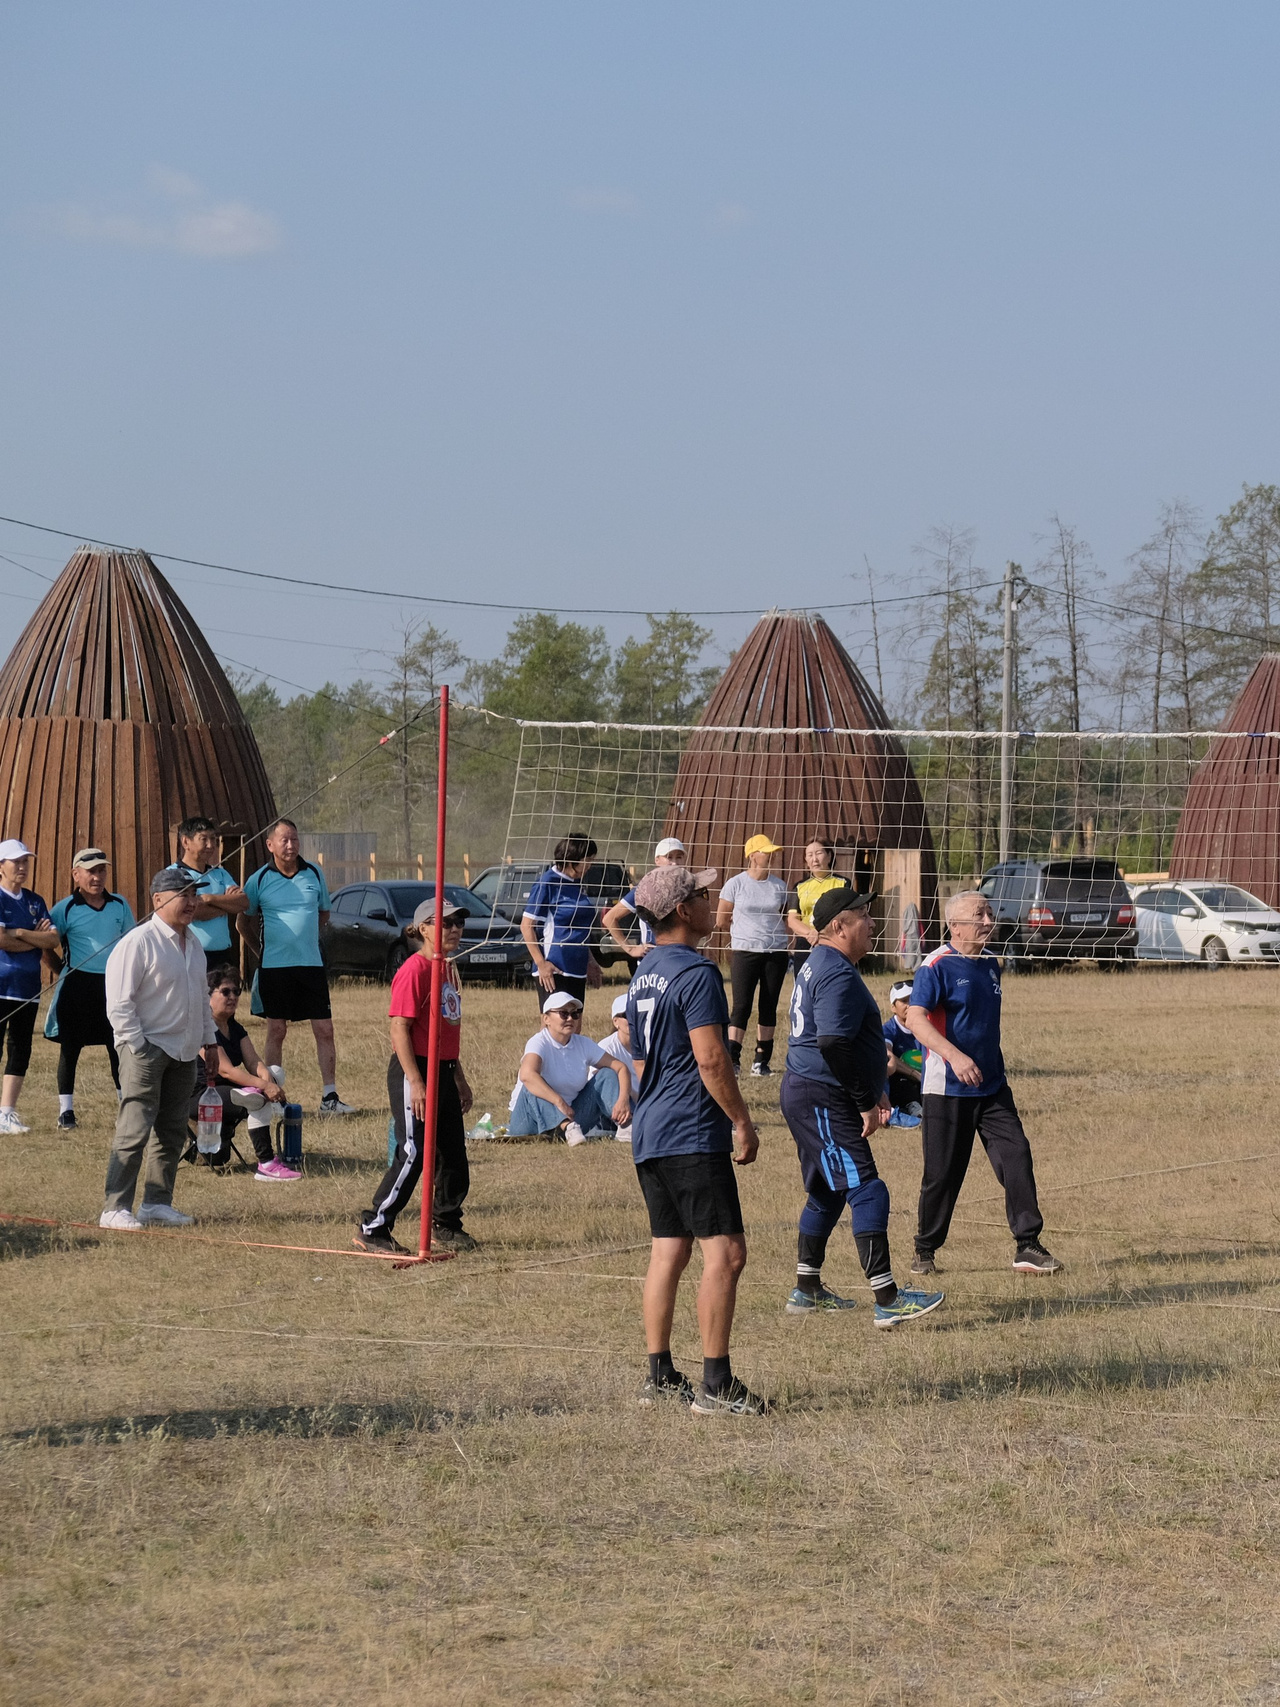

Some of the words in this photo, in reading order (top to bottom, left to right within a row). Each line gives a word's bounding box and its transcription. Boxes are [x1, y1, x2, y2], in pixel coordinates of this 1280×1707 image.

[656, 976, 669, 994] 88
[789, 984, 805, 1037] 3
[636, 997, 655, 1055] 7
